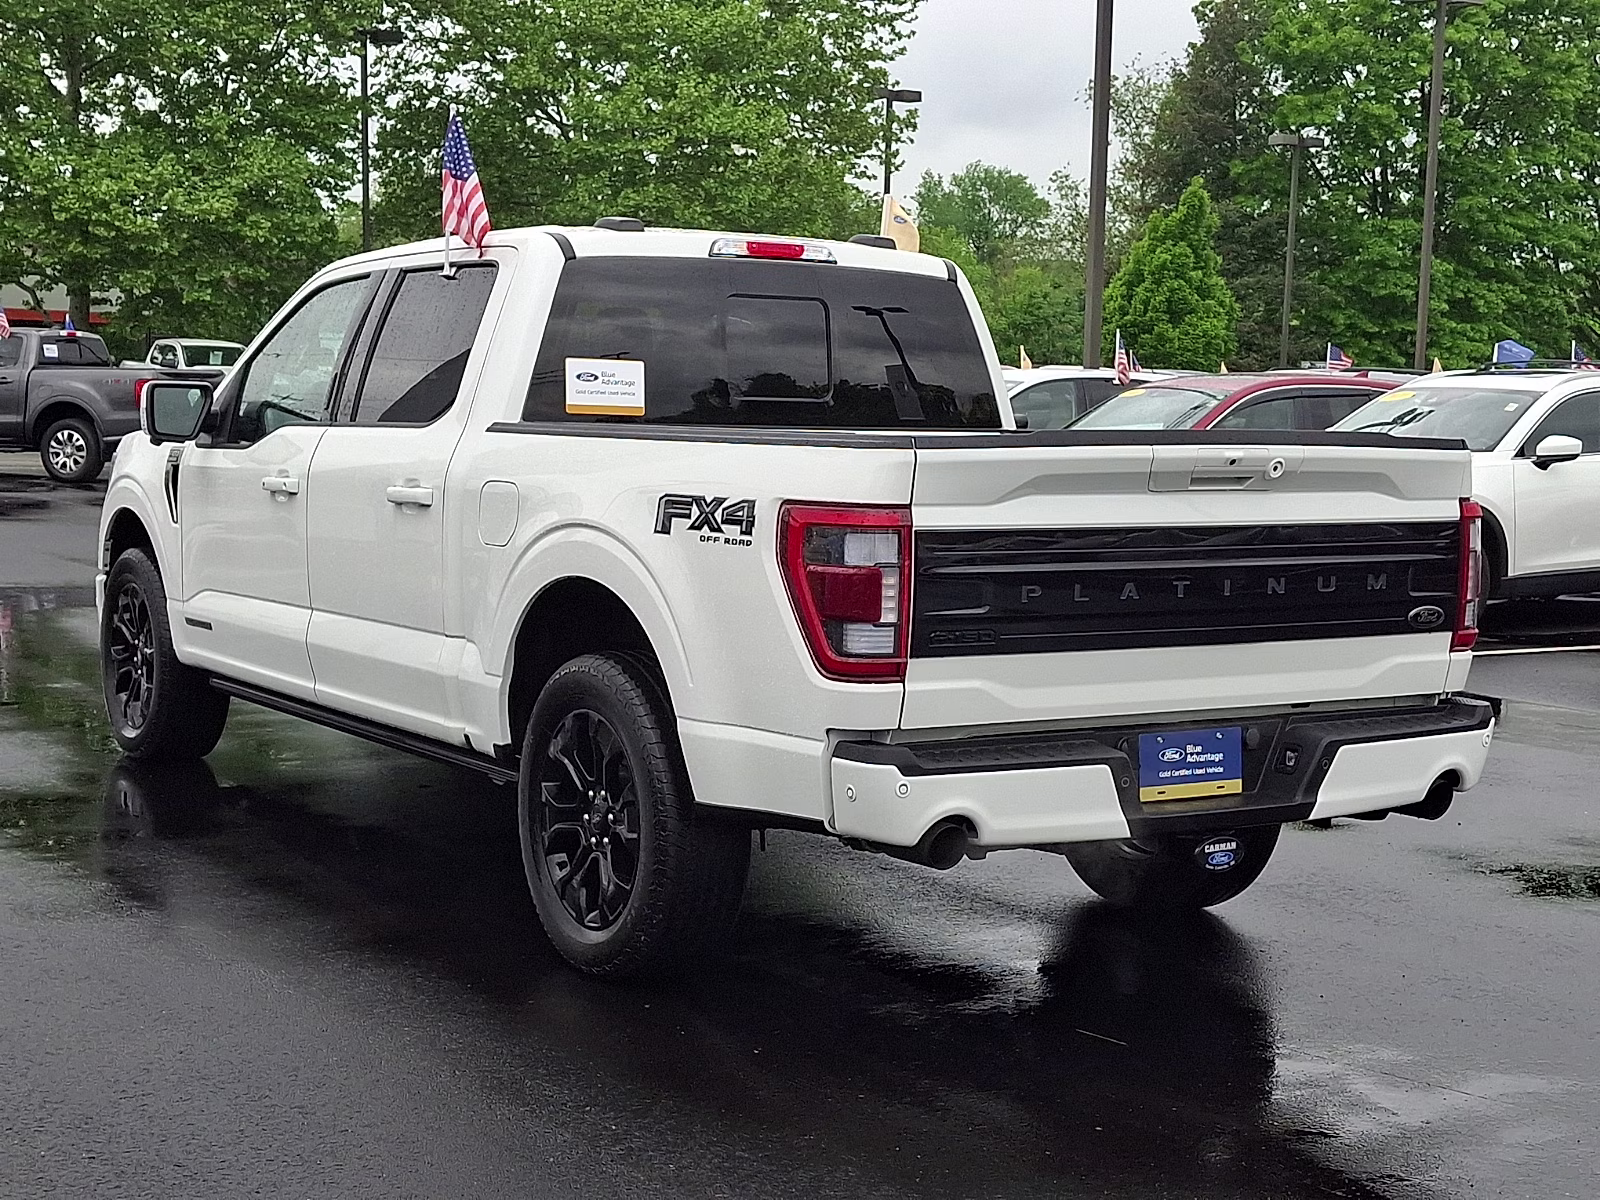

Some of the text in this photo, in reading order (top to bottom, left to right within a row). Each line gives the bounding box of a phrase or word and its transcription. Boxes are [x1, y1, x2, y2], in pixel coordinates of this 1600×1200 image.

[601, 379, 636, 387] Advantage
[653, 493, 757, 537] FX4
[699, 535, 753, 547] OFF ROAD
[1021, 573, 1387, 603] PLATINUM
[1186, 745, 1202, 753] Blue
[1186, 752, 1224, 763] Advantage
[1159, 766, 1224, 778] Gold Certified Used Vehicle
